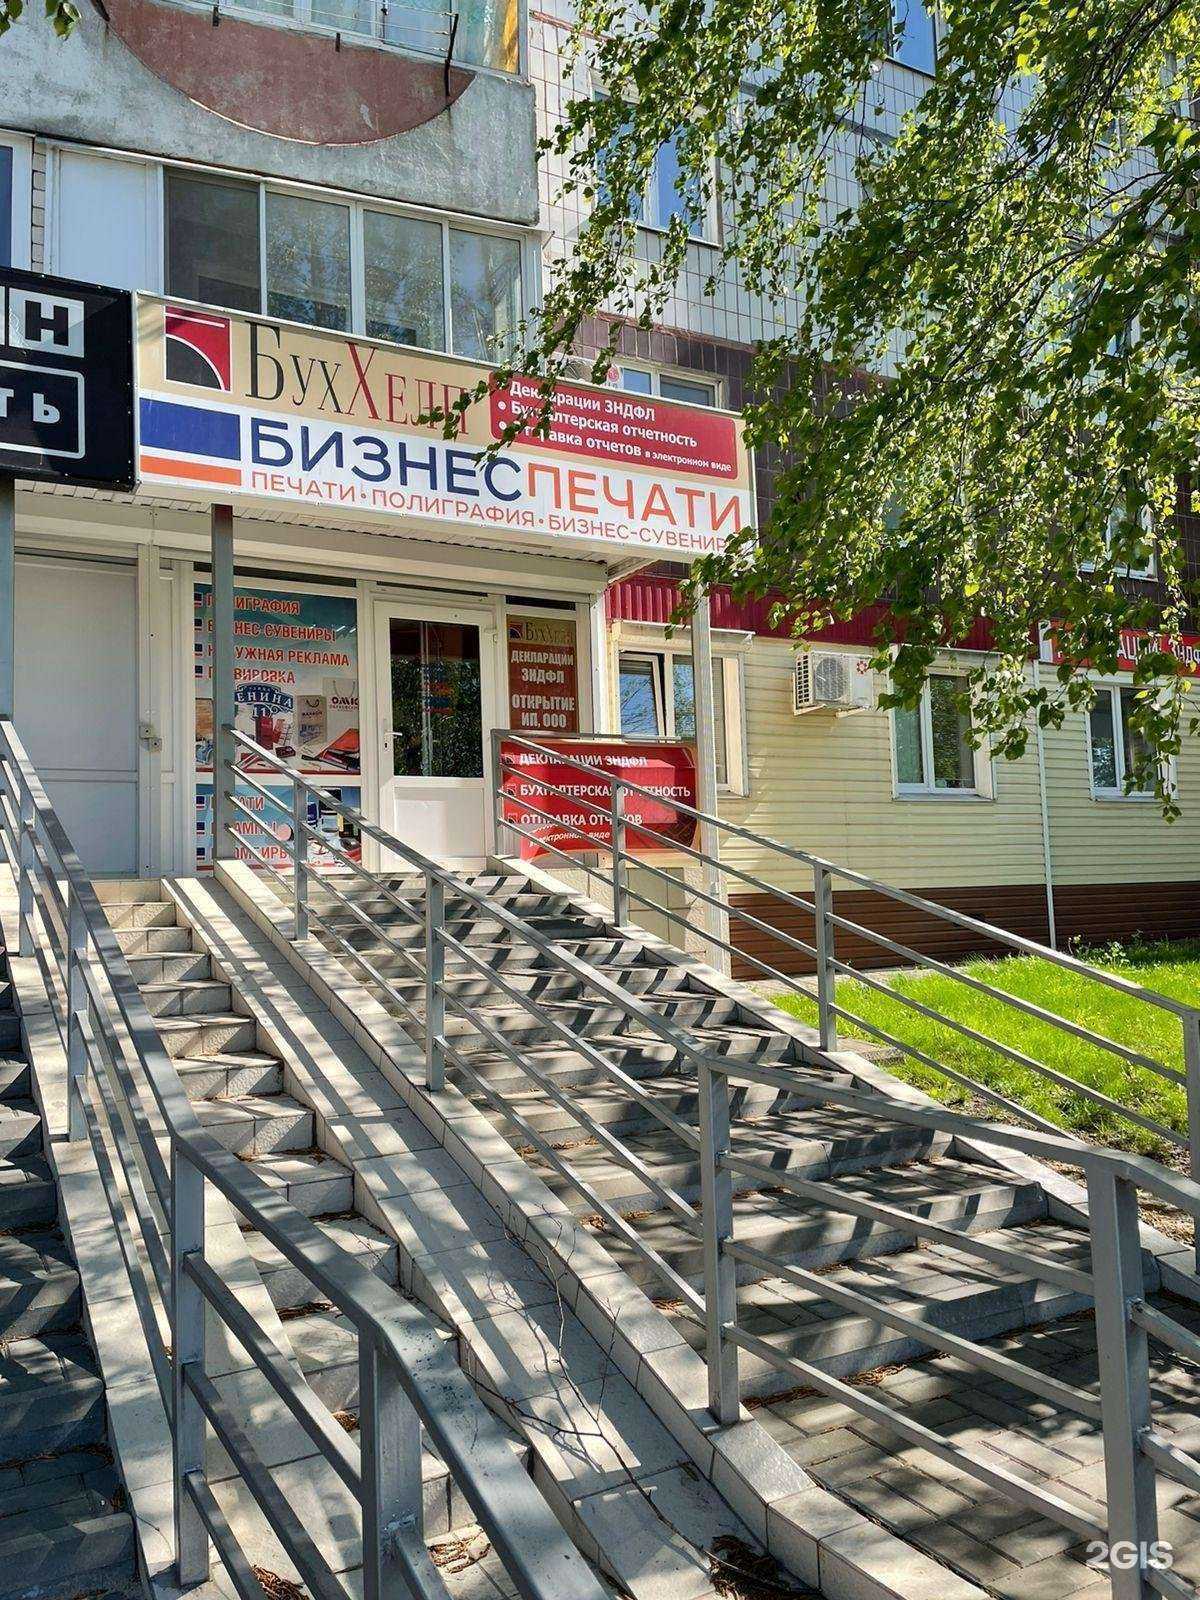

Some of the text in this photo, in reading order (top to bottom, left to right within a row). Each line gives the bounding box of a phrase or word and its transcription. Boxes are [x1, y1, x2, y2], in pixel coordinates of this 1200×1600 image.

[510, 381, 601, 411] Декарации
[622, 424, 698, 447] отчетность
[586, 437, 642, 457] отчетов
[645, 451, 651, 459] в
[652, 452, 709, 468] электронном
[711, 462, 732, 472] виде
[252, 470, 733, 553] ПЕЧАТИ ПОЛИГРАФИЯ БИЗНЕС-СУВЕНИР
[206, 593, 300, 614] ПИГРАФИЯ
[207, 619, 336, 642] БНЕС СУВЕНИРЫ
[207, 644, 350, 667] НУЖНАЯ РЕКЛАМА
[511, 650, 574, 666] ДЕКЛАРАЦИИ
[207, 665, 296, 684] ГВИРОВКА
[237, 690, 292, 708] ЕНИНА
[511, 694, 575, 711] ОТКРЫТИЕ
[543, 713, 567, 727] ООО
[520, 753, 602, 766] ДЕКЛААЦИИ
[521, 812, 587, 826] ОТПАВКА
